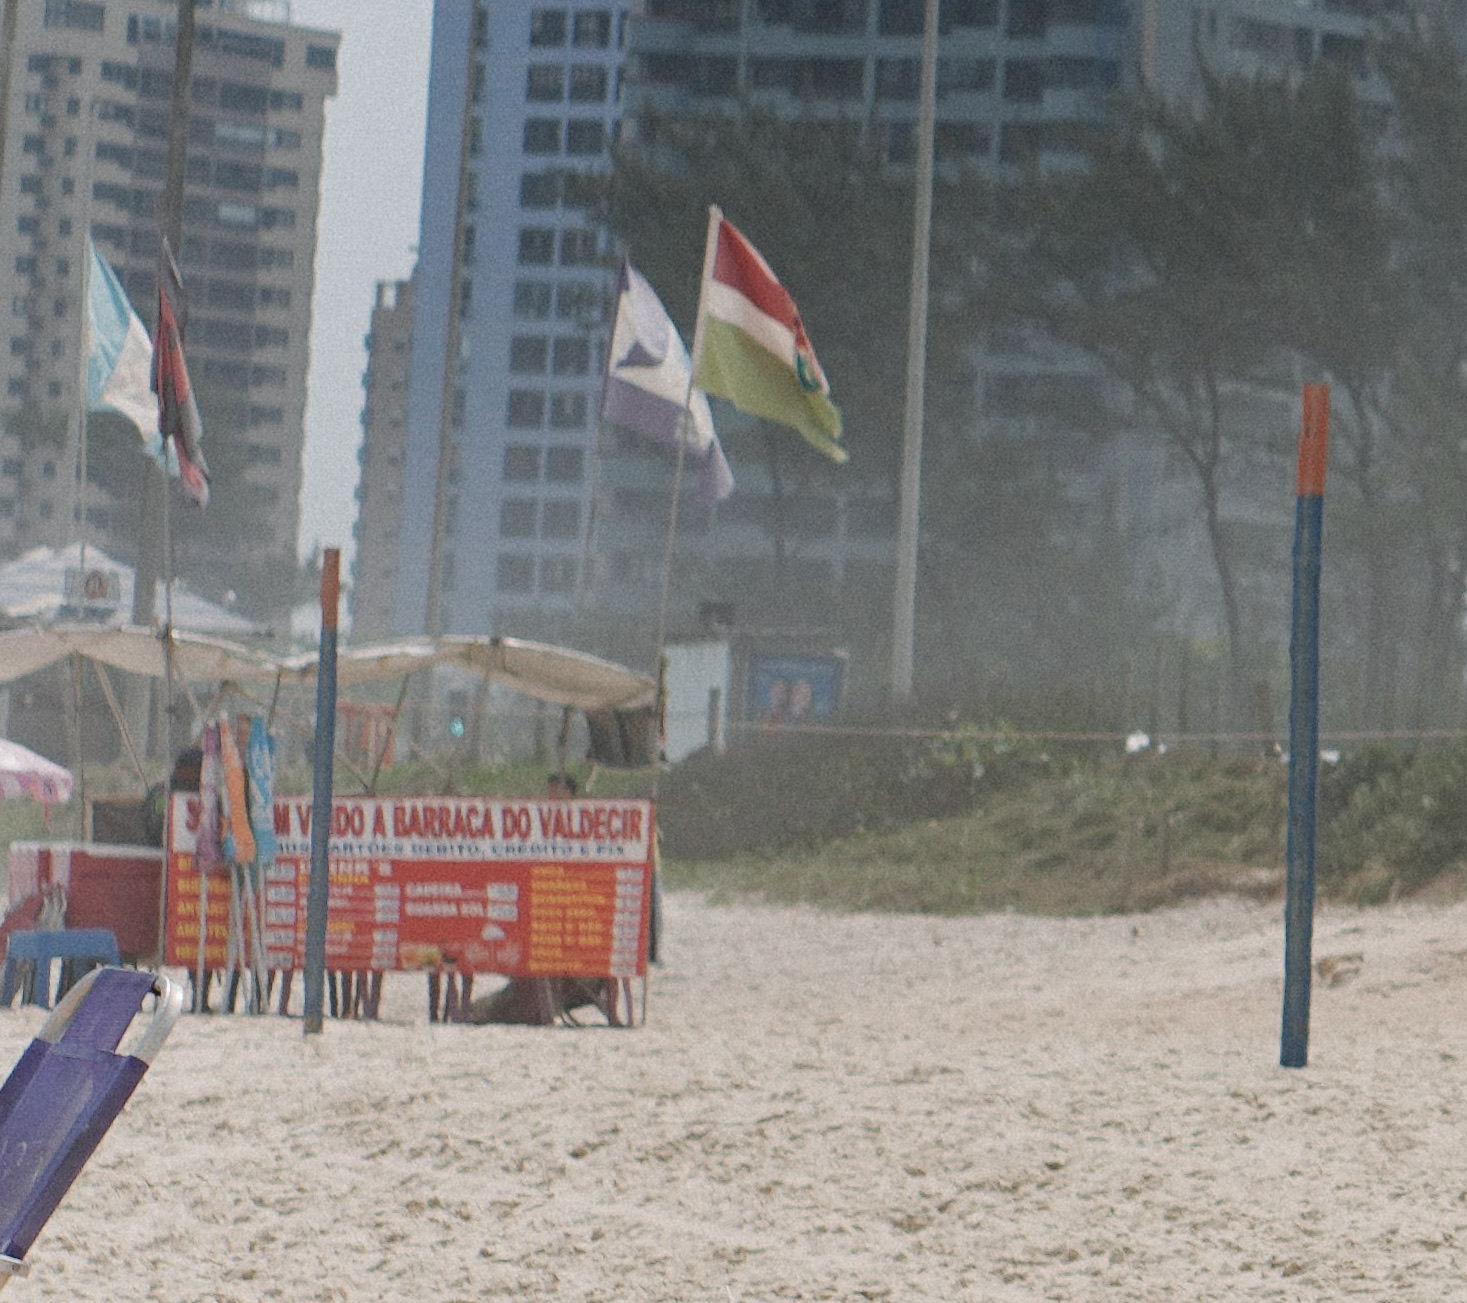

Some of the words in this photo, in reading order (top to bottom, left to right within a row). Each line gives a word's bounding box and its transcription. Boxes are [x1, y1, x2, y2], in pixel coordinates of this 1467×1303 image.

[374, 806, 387, 839] A
[393, 805, 495, 839] BARRACA
[502, 807, 532, 839] DO
[539, 807, 643, 840] VALDECIR
